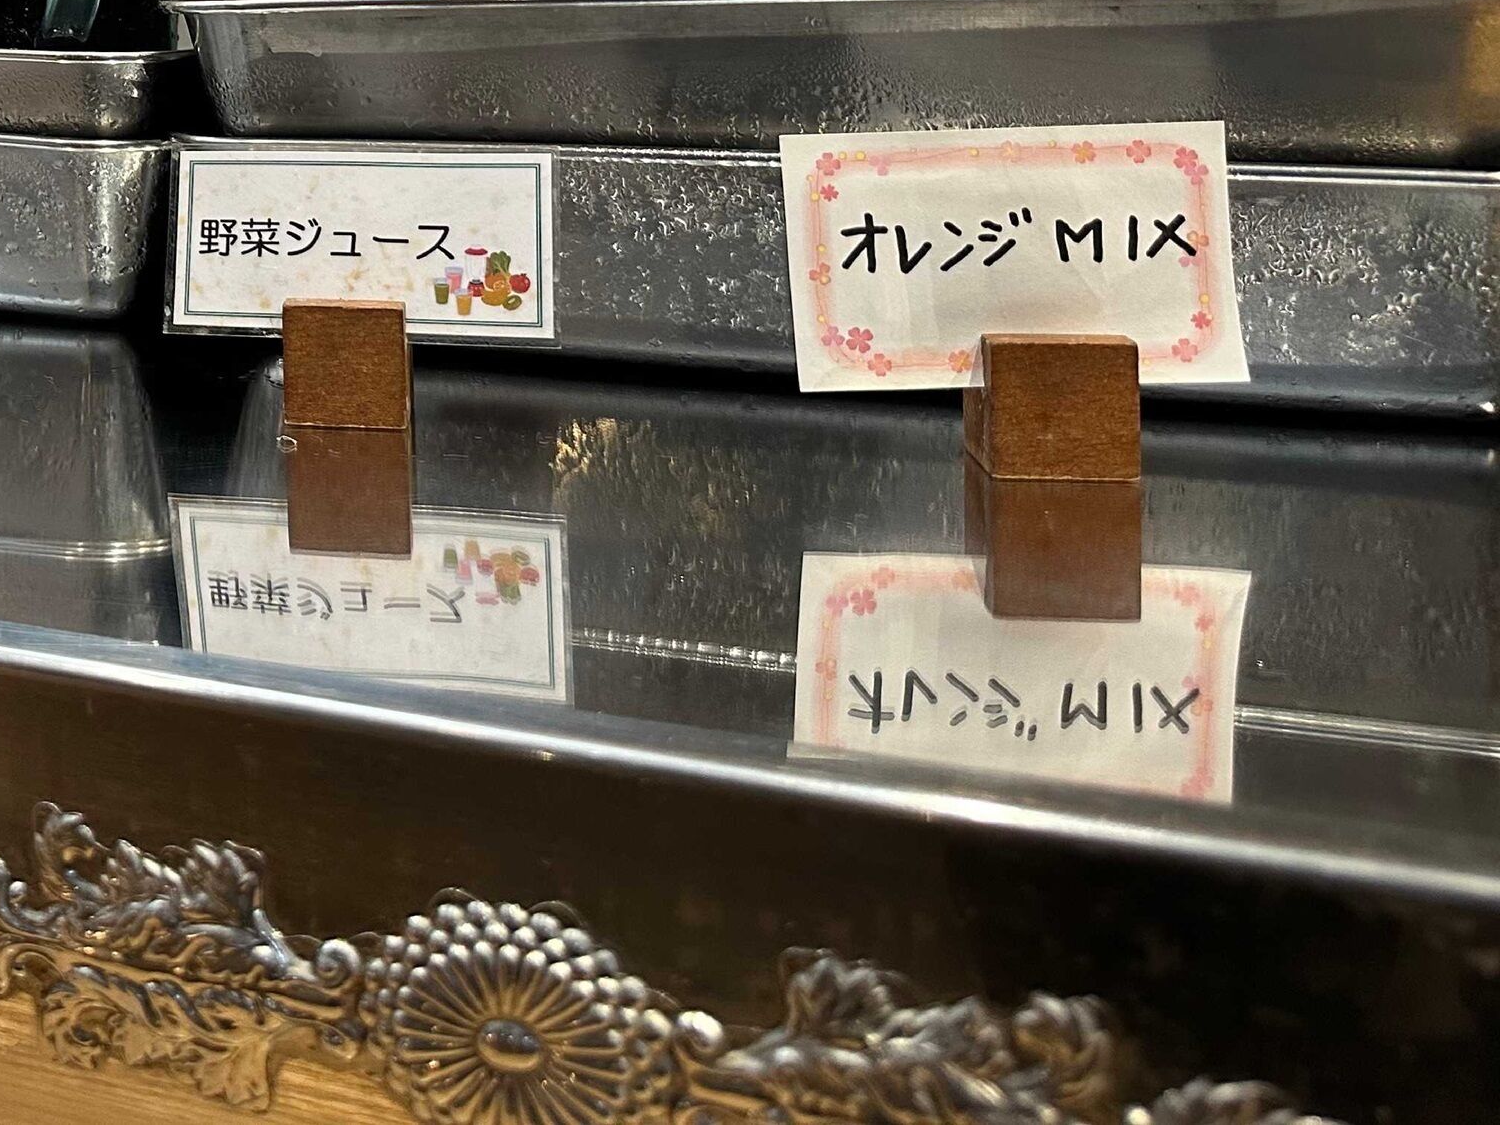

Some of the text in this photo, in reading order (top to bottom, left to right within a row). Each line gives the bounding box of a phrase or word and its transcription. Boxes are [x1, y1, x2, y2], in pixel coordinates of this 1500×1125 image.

[197, 217, 456, 262] 野菜ジュース
[841, 207, 1199, 274] オレンジ MIX
